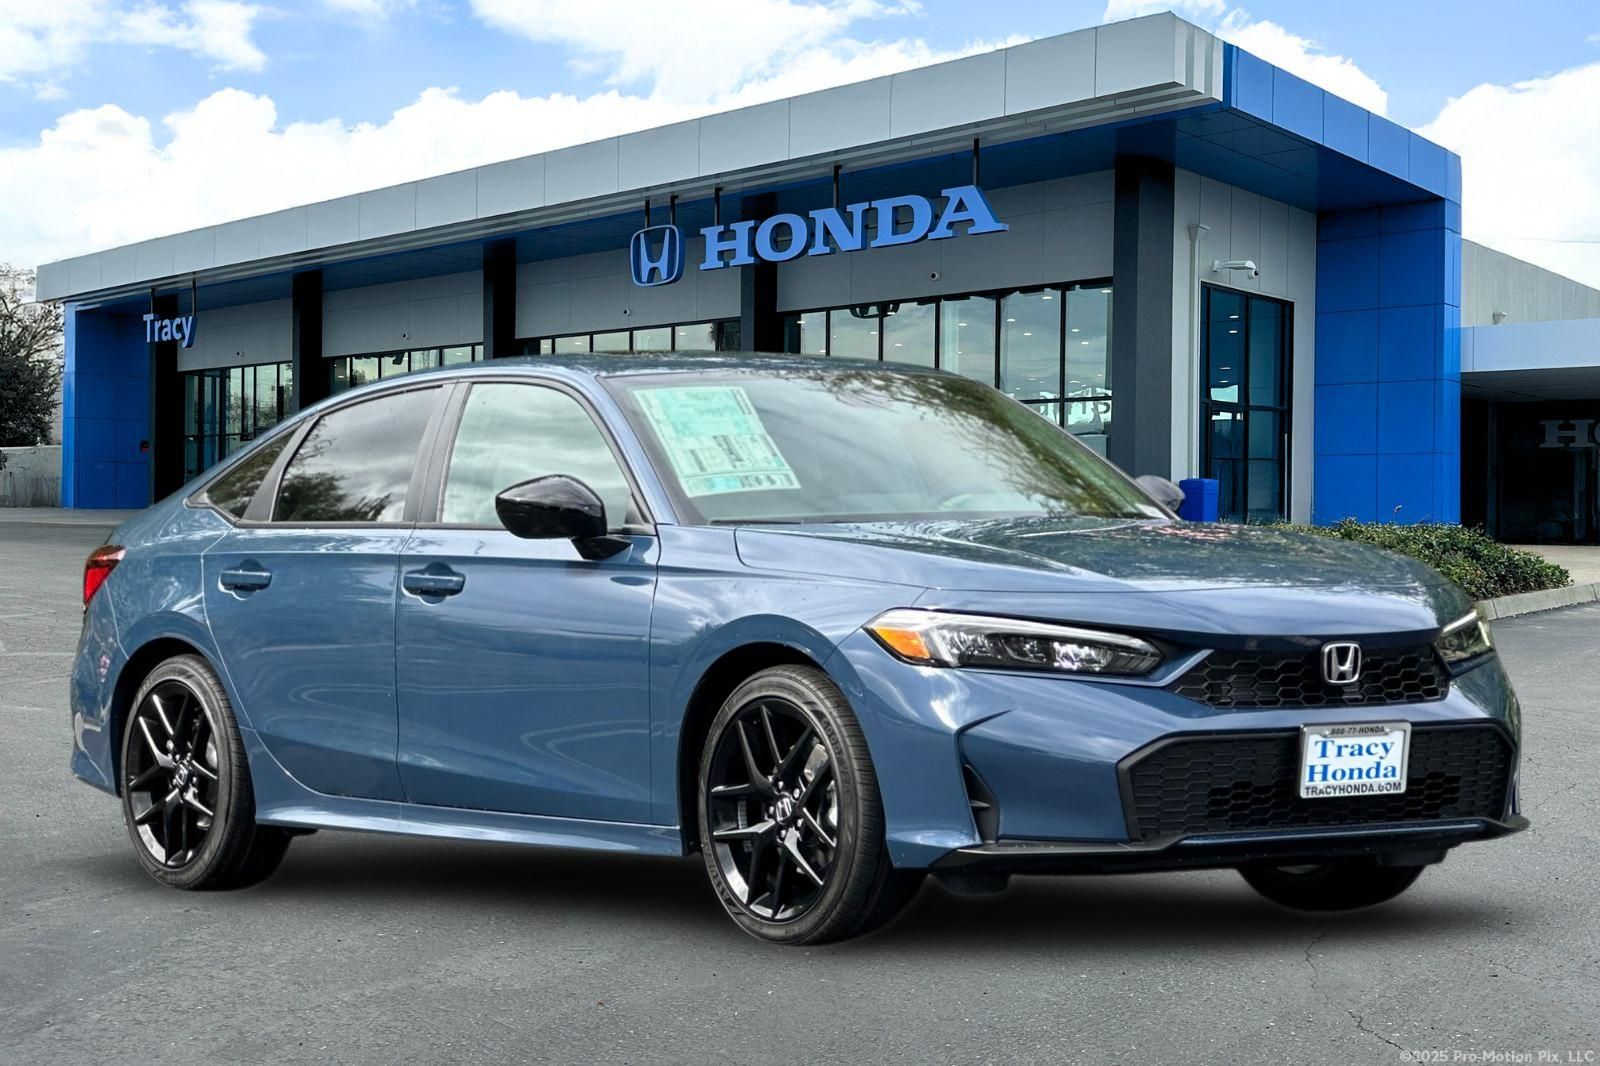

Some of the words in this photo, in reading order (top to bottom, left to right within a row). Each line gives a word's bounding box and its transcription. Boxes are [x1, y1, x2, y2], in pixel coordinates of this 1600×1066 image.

[700, 184, 1009, 271] HONDA
[143, 313, 194, 349] Tracy
[1539, 419, 1600, 448] H
[1314, 739, 1395, 760] Tracy
[1307, 761, 1397, 783] Honda
